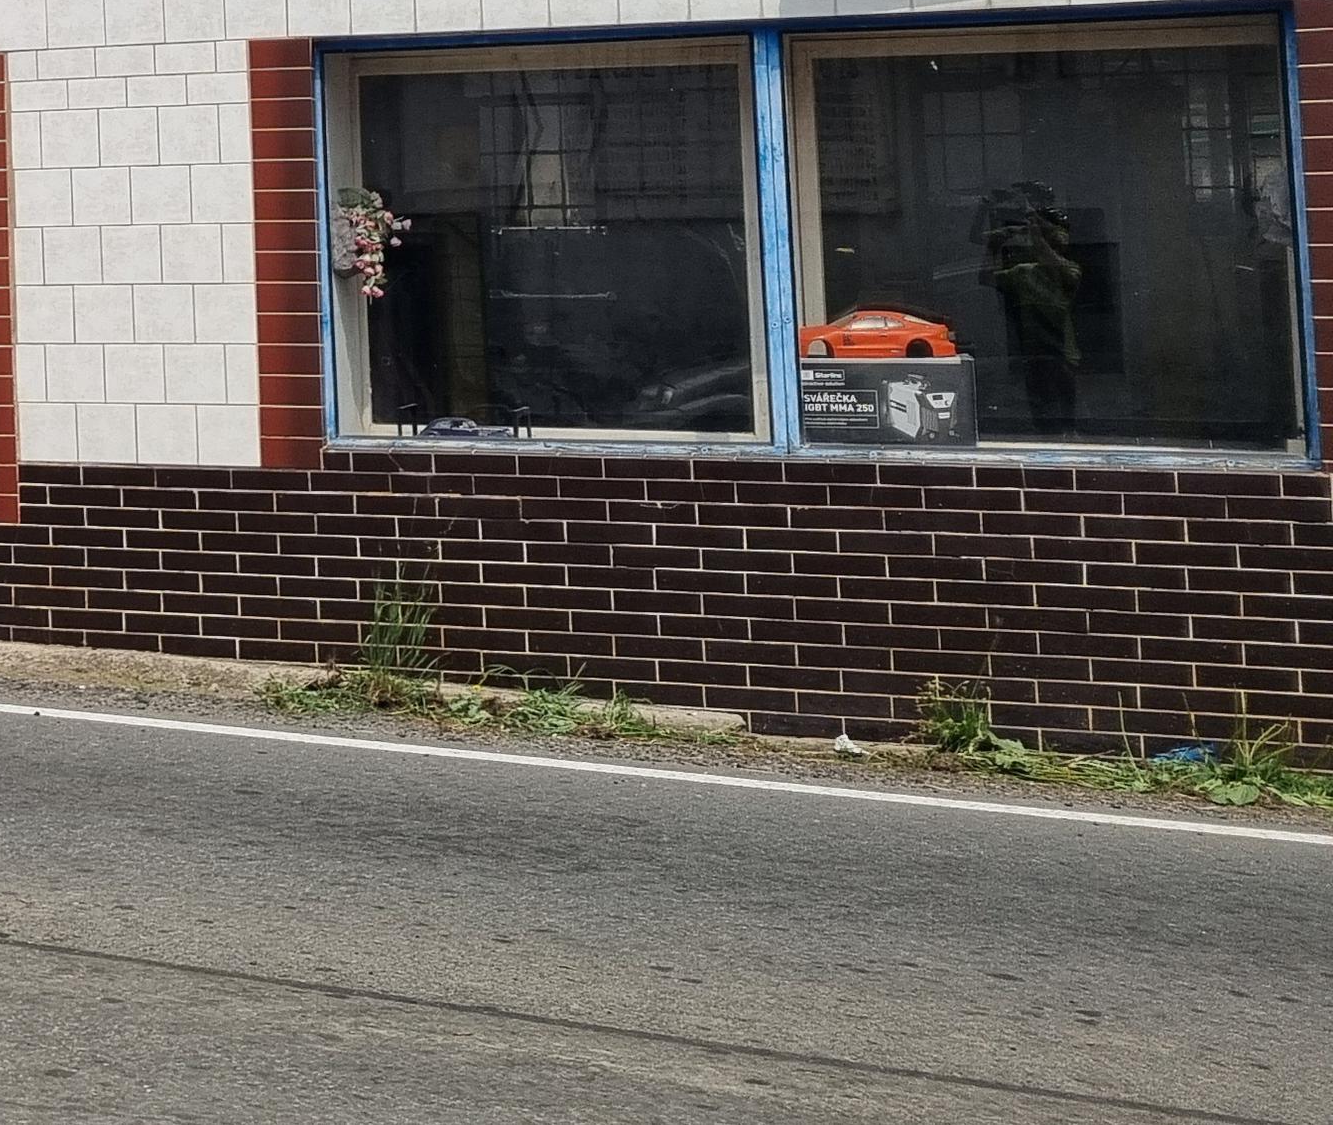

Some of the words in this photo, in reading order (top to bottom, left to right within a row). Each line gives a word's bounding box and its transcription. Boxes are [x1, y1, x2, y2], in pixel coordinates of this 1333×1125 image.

[803, 392, 857, 403] SVÁŘEČKA
[804, 403, 828, 412] IGBT
[830, 403, 855, 412] MMA
[856, 403, 874, 413] 250
